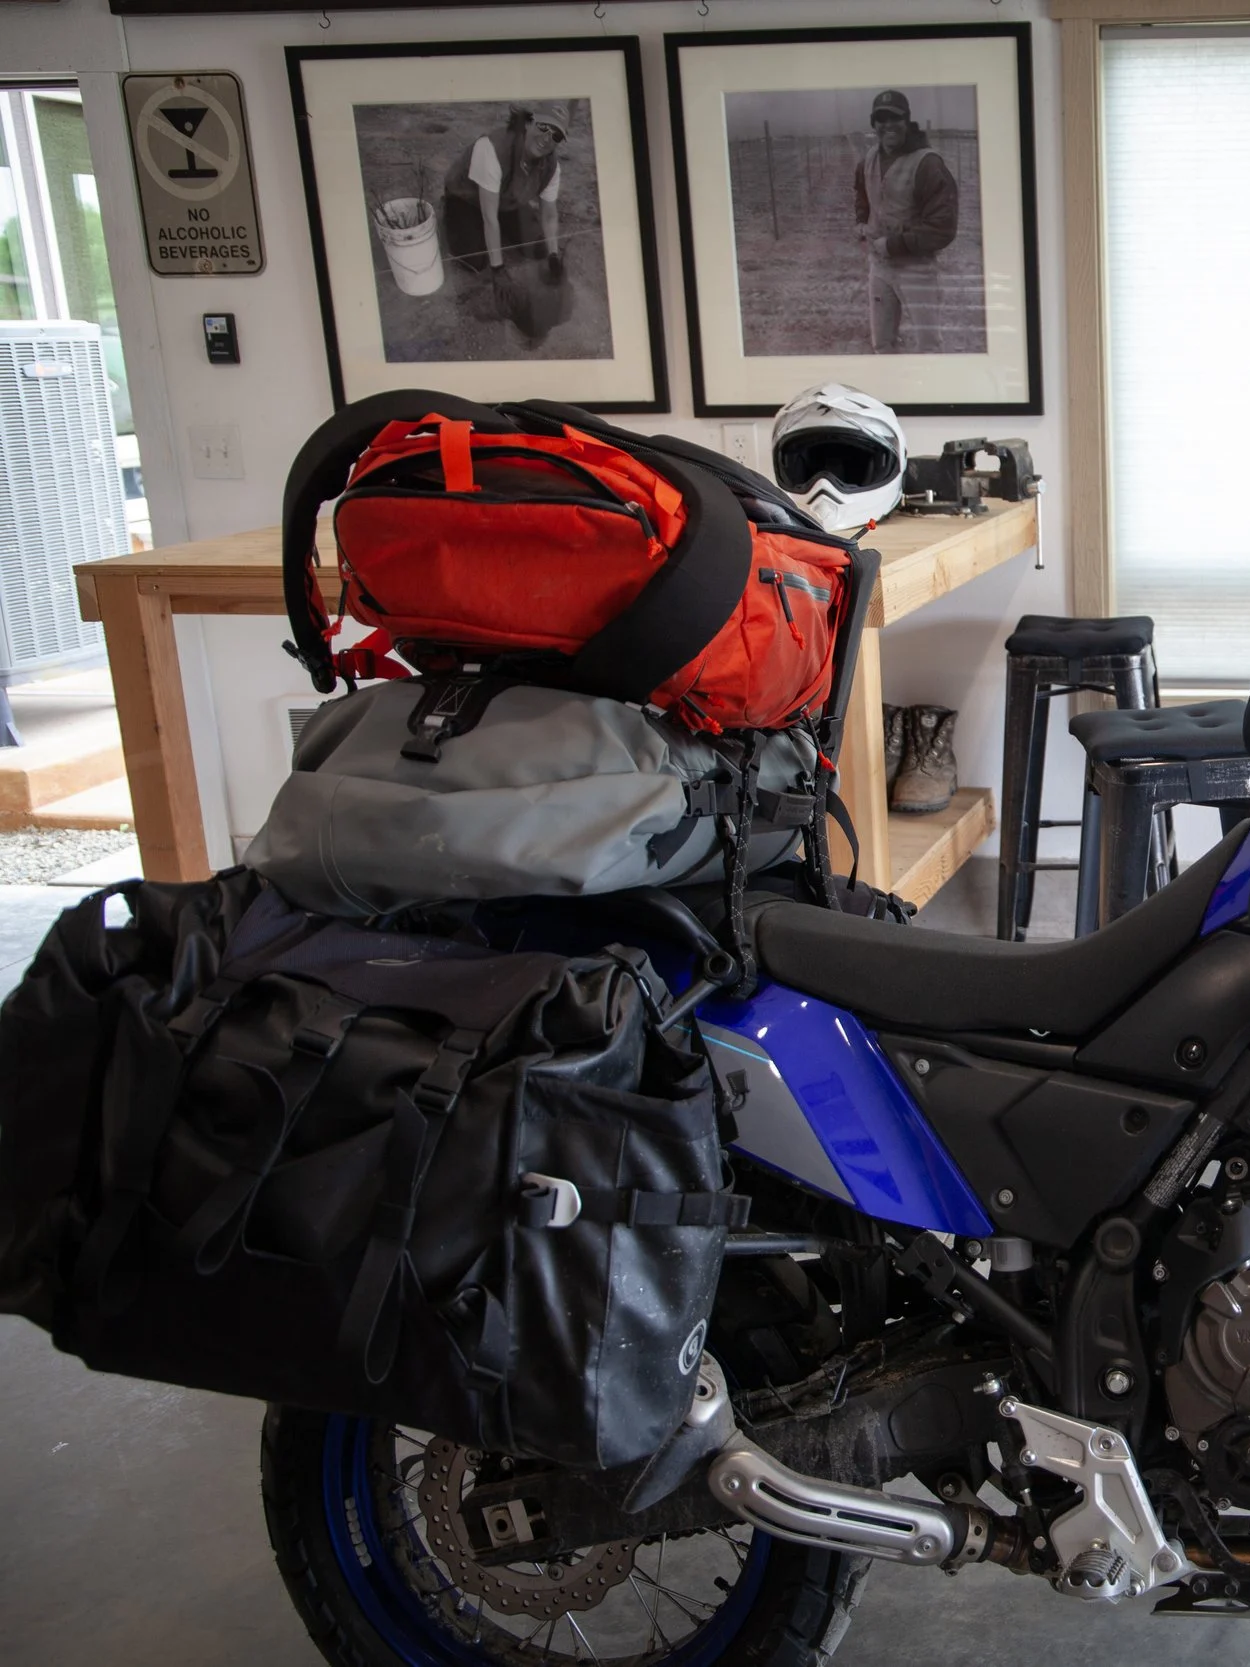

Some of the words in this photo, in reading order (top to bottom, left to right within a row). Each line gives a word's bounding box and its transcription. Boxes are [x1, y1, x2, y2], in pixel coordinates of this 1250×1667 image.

[187, 207, 210, 222] NO
[158, 225, 248, 241] ALCOHOLIC
[158, 244, 250, 260] BEVERAGES
